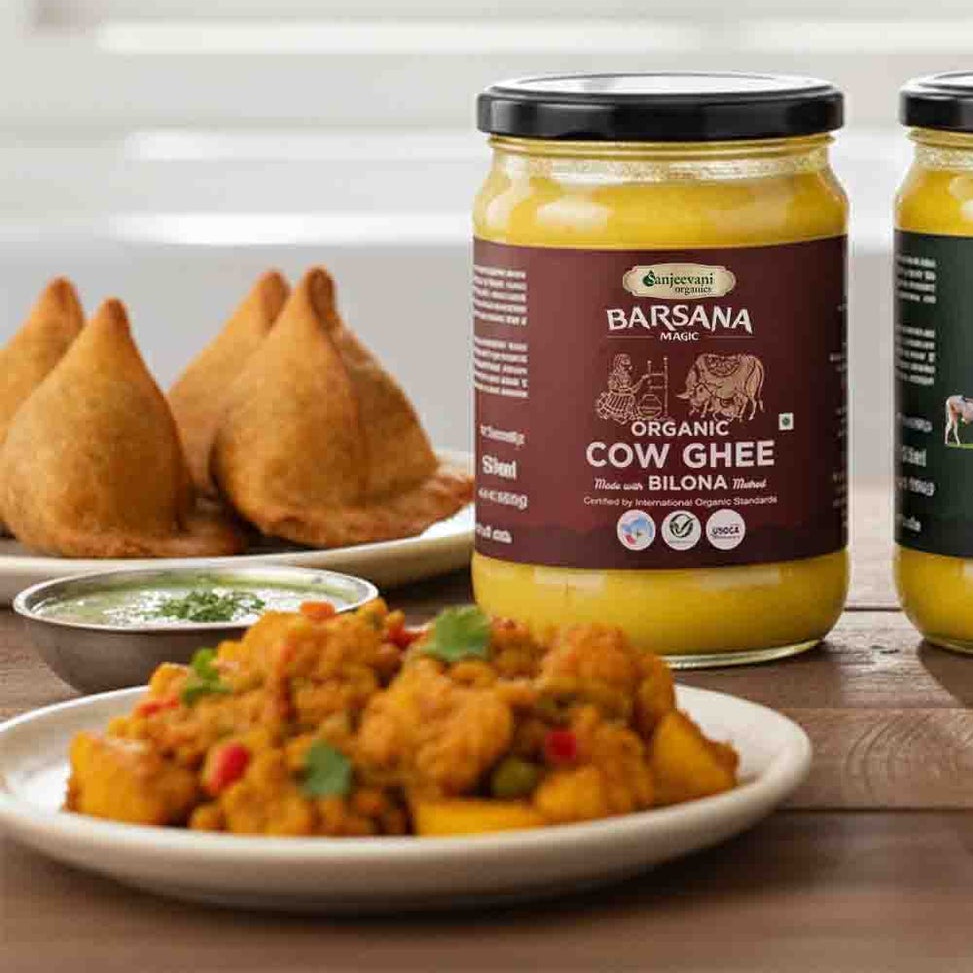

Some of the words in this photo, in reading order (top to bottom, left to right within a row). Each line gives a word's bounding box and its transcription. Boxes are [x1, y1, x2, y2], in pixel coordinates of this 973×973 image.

[643, 270, 713, 288] Sanjeevani
[674, 285, 712, 295] organics
[606, 304, 753, 334] BARSANA
[659, 332, 700, 341] MAGIC
[631, 421, 729, 436] ORGANIC
[586, 441, 670, 469] COW
[683, 440, 775, 468] GHEE
[594, 478, 622, 490] Made
[648, 475, 728, 491] BILONA
[583, 496, 620, 506] Certified
[622, 498, 633, 508] by
[635, 499, 693, 507] International
[694, 497, 732, 507] Organic
[733, 496, 778, 506] Standards
